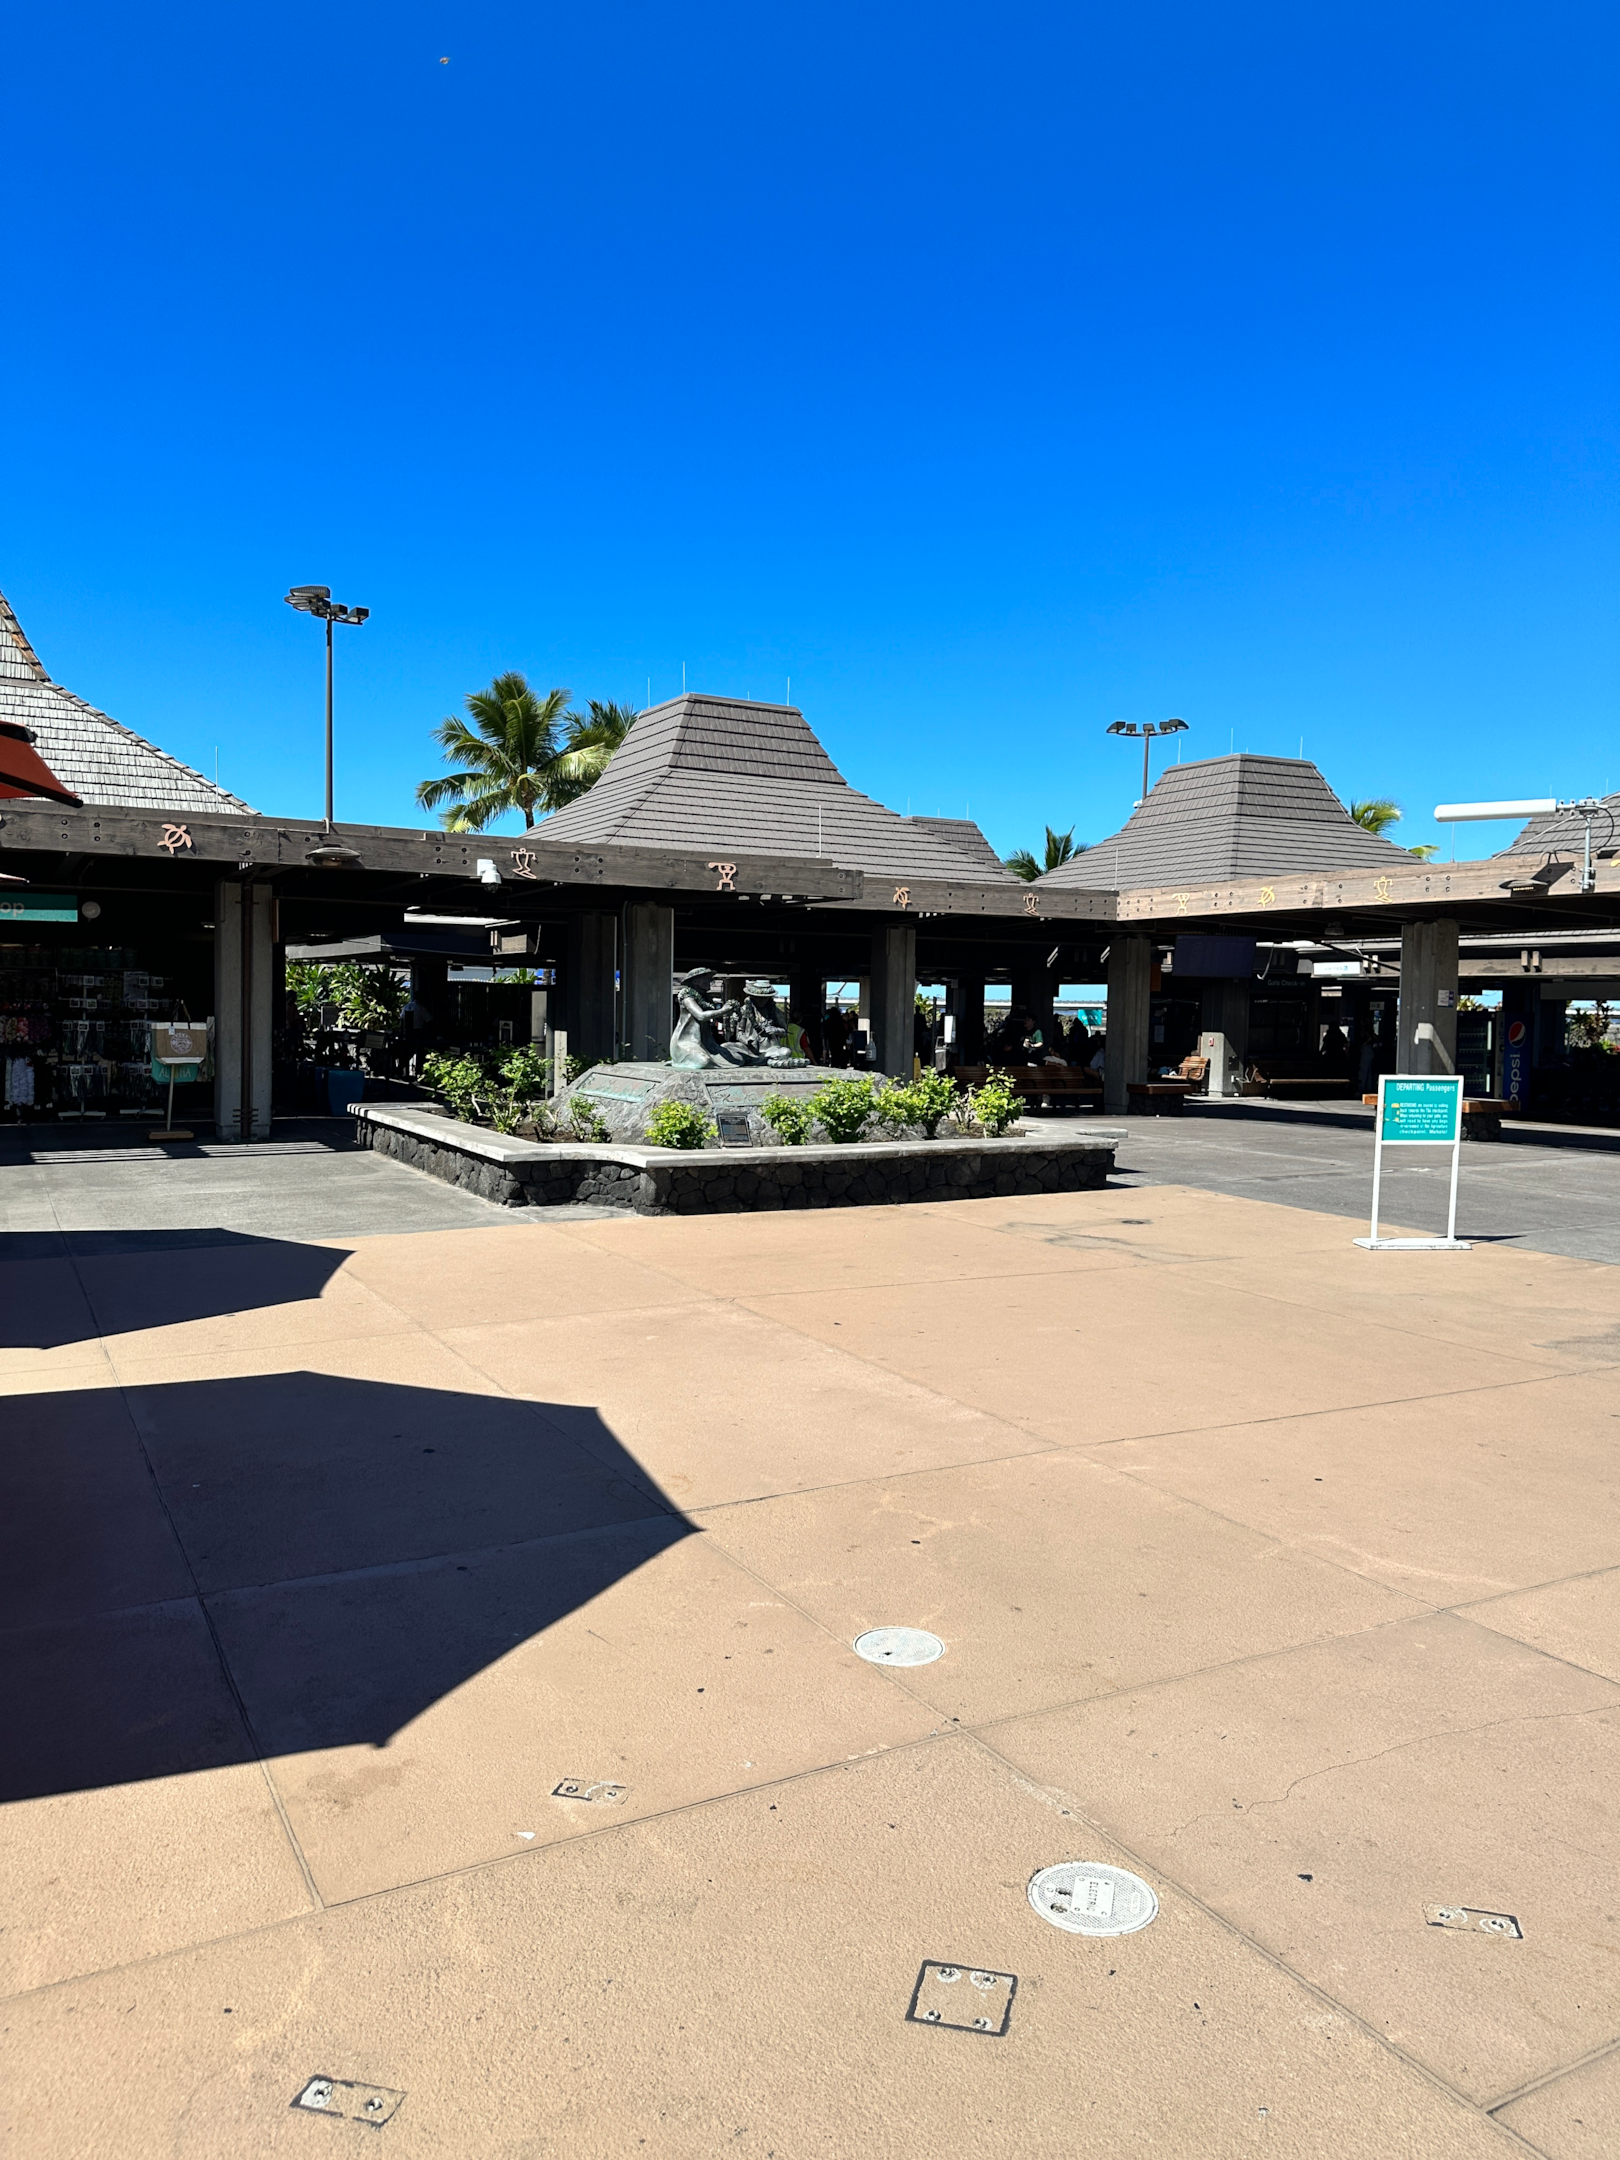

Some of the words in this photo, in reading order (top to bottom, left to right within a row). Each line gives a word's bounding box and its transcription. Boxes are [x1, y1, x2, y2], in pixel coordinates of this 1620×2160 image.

[1267, 978, 1281, 987] Gate
[1281, 979, 1306, 987] Check-in
[1396, 1083, 1424, 1091] DEPARTING
[1426, 1083, 1455, 1093] Passengers
[1086, 1881, 1099, 1912] ELECTRIC
